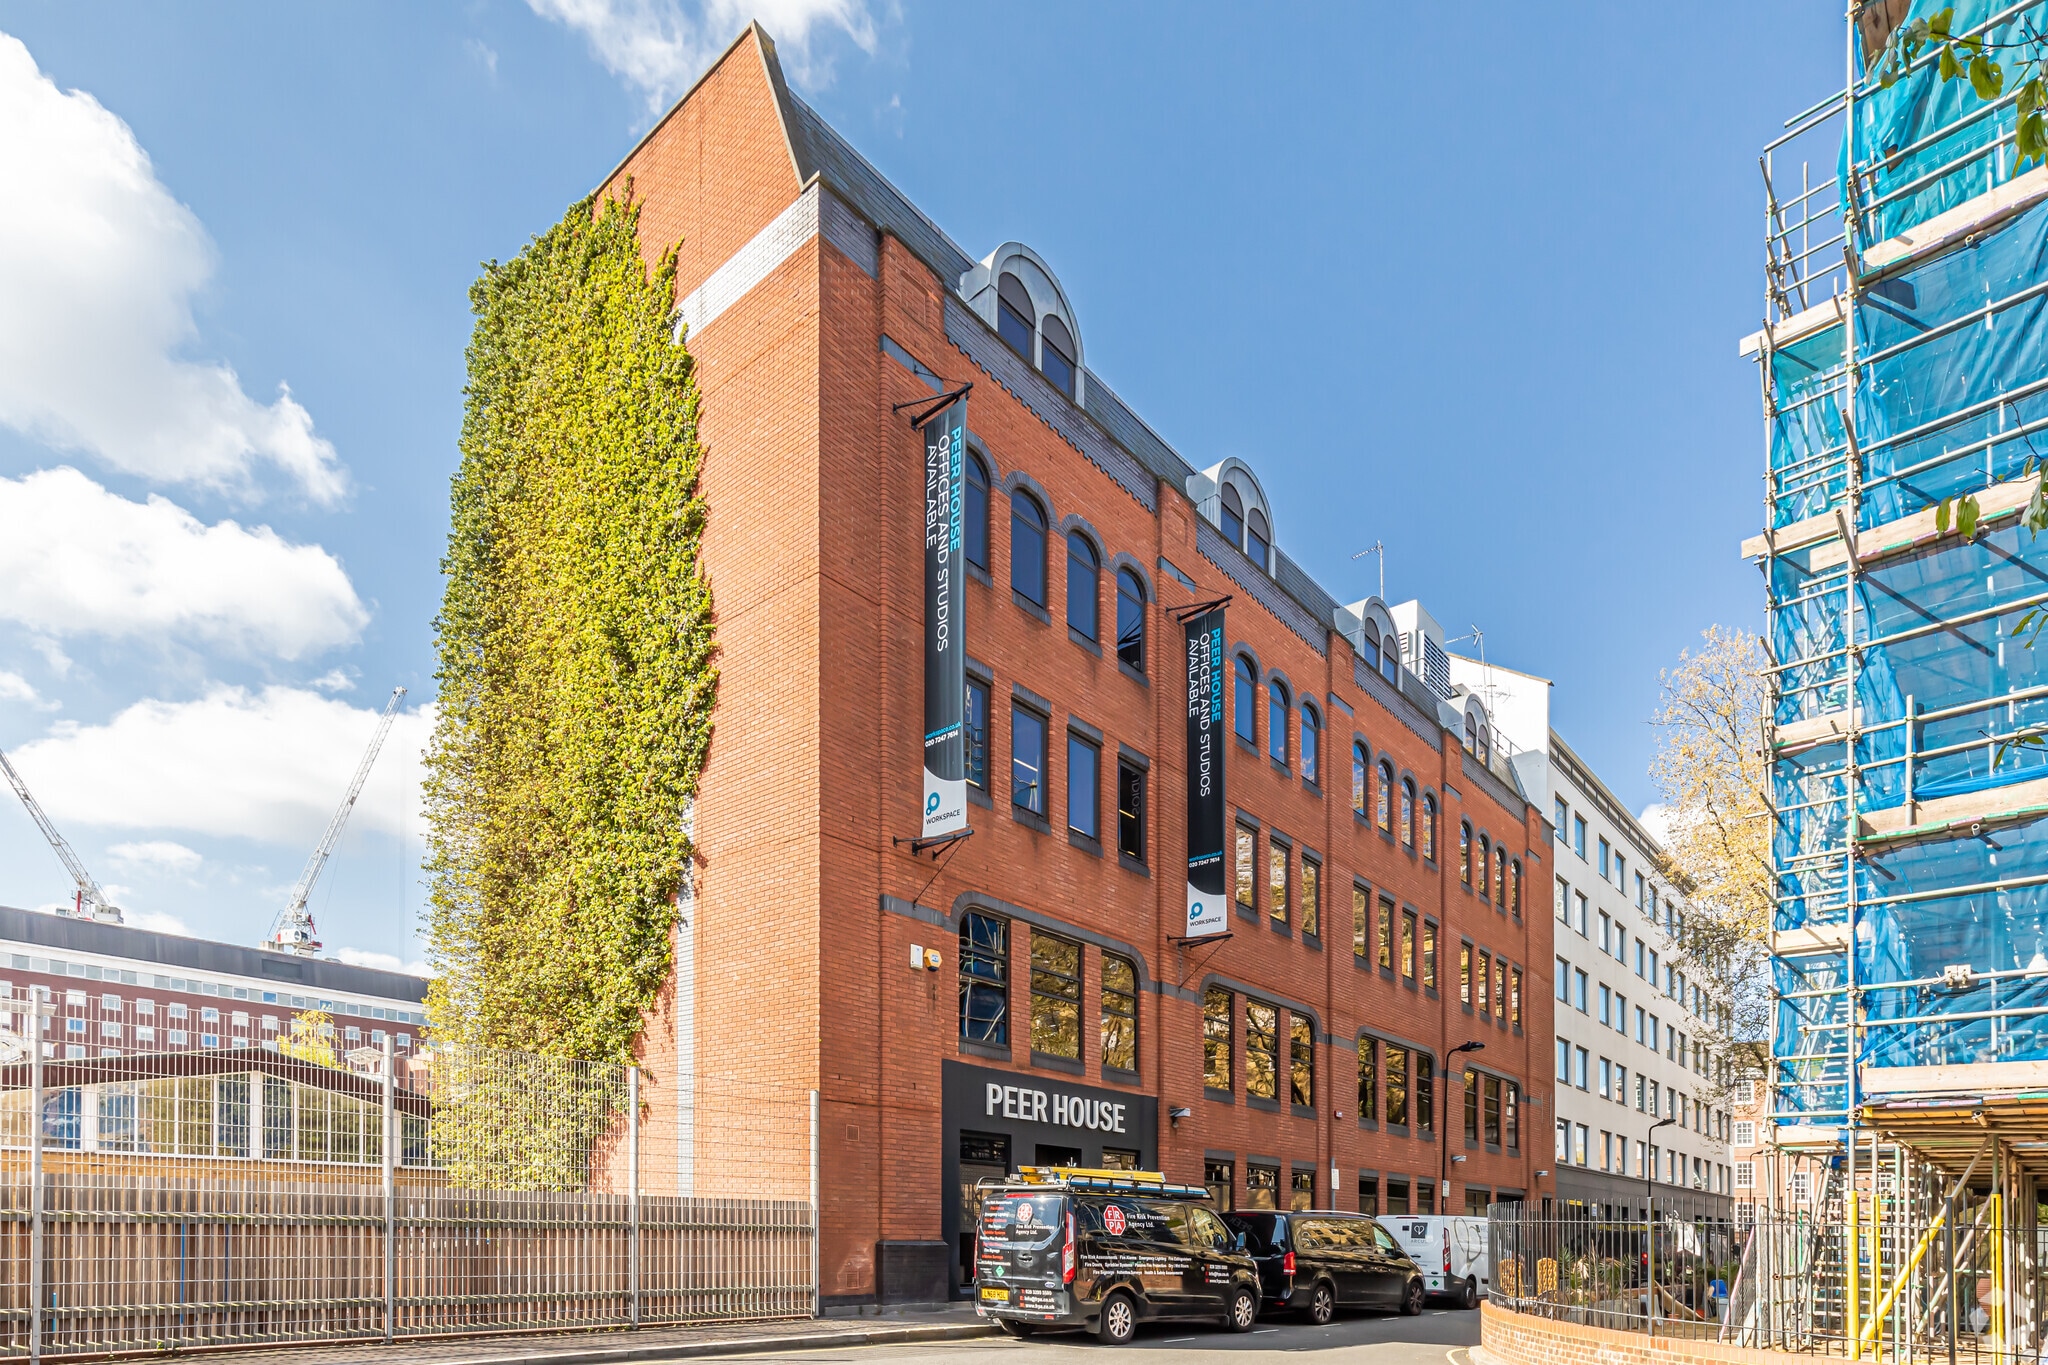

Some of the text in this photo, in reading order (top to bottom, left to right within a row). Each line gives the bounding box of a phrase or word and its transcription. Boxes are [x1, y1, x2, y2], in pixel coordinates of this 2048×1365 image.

[926, 445, 938, 550] AVAILABLE
[950, 425, 962, 552] PEER HOUSE
[937, 434, 950, 652] OFFICES AND STUDIOS
[1188, 638, 1199, 718] AVAILABLE
[1200, 632, 1211, 797] OFFICES AND STUDIOS
[1211, 627, 1221, 723] PEER HOUSE
[924, 738, 935, 748] 020
[926, 808, 960, 825] WORKSPACE
[1190, 916, 1222, 927] WORKSPACE
[986, 1082, 1126, 1134] PEER HOUSE
